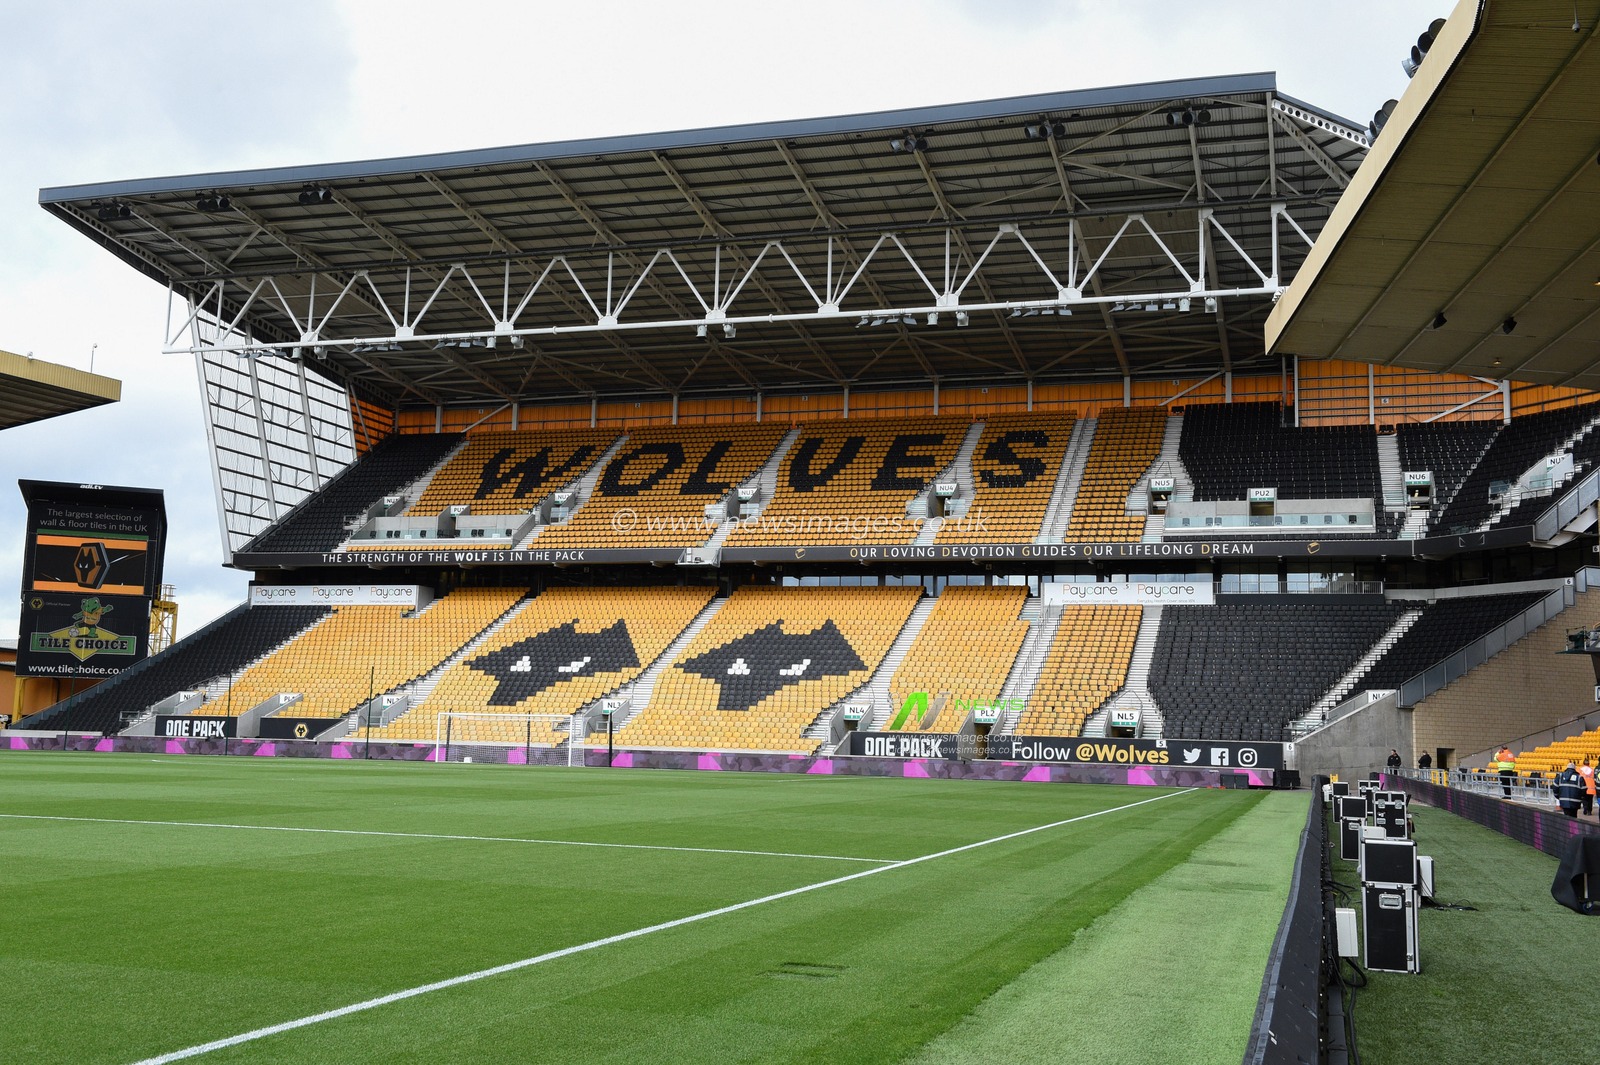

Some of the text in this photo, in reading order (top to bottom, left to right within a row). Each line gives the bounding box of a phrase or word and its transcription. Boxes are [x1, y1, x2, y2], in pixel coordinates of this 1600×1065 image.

[474, 430, 1051, 500] WOLVES
[47, 508, 143, 522] The largest selection of
[40, 519, 148, 532] wall & floor tiles in the UK
[322, 551, 585, 563] THE STRENGTH OF THE WOLF IS IN THE PACK
[850, 543, 1254, 558] OUR LOVING DEVOTION GUIDES OUR LIFELONG DREAM
[255, 587, 296, 599] Paycare
[312, 586, 354, 599] Paycare
[370, 586, 413, 599] Paycare
[1062, 584, 1118, 598] Paycare
[1137, 584, 1195, 598] Paycare
[39, 637, 128, 650] TILE CHOICE
[28, 664, 131, 675] www.tilehoice.co.
[1117, 712, 1135, 721] NL5
[165, 719, 226, 738] ONE PACK
[864, 736, 943, 758] ONE PACK
[1012, 741, 1071, 761] Follow
[1075, 743, 1169, 764] @Wolves
